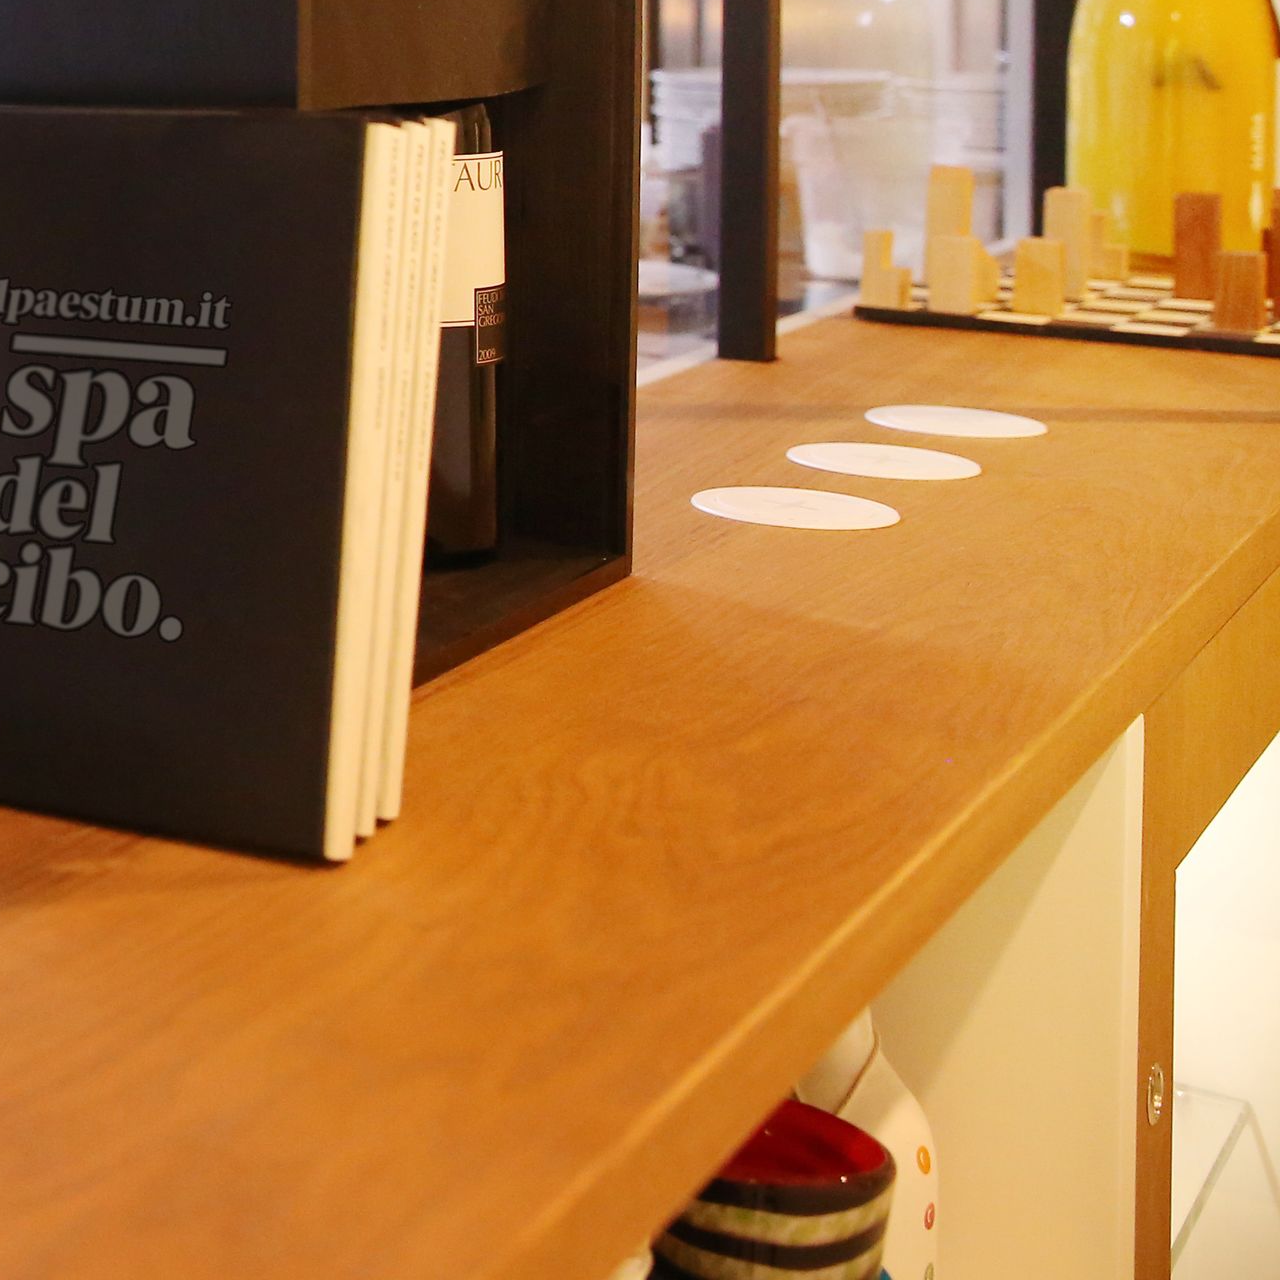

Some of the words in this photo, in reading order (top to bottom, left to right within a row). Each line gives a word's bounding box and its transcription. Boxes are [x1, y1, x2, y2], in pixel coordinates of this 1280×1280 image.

[452, 160, 502, 192] AUR
[478, 304, 494, 317] SAN
[0, 363, 195, 467] spa
